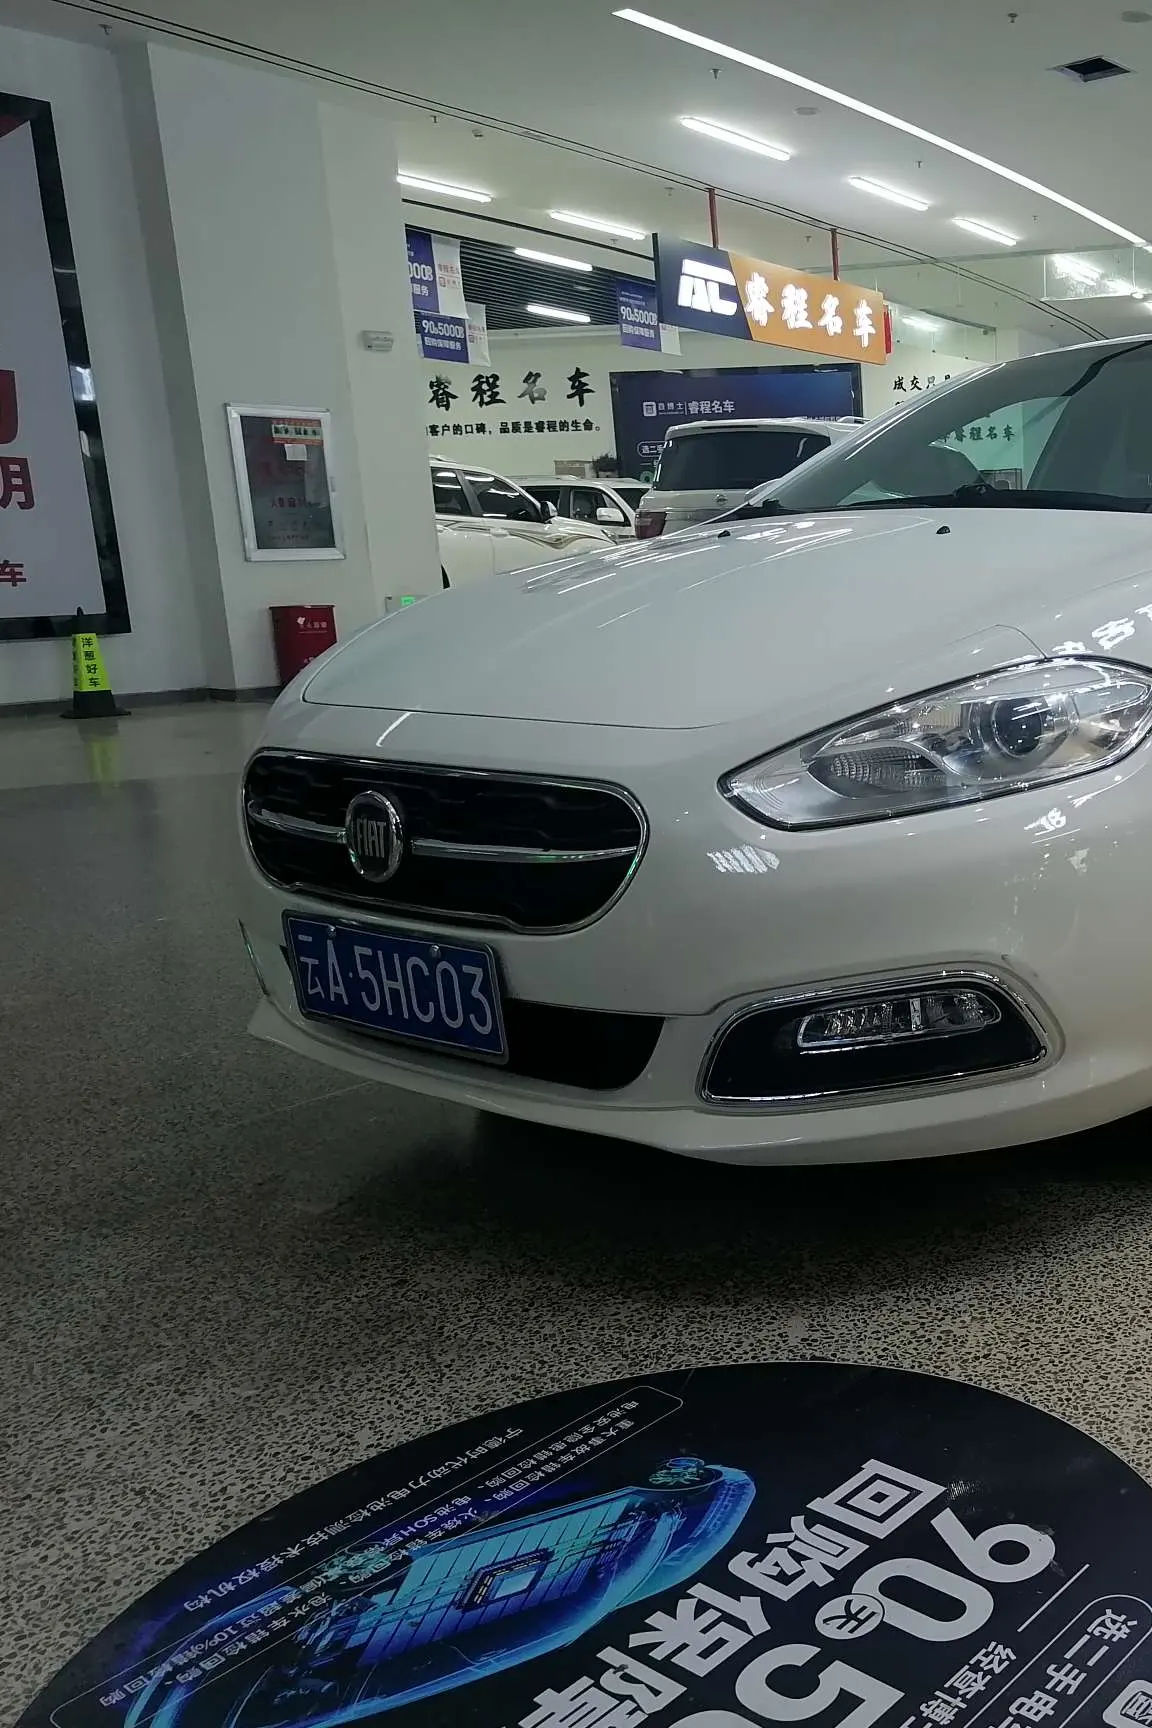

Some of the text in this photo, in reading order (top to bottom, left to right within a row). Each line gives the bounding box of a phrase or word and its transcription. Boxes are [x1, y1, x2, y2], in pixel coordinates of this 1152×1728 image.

[427, 366, 597, 412] 睿程名车
[688, 400, 736, 415] 睿程名车
[425, 418, 601, 437] 客户的口碑，品质是睿程的生命。
[354, 816, 387, 860] FIAT
[183, 1426, 524, 1613] 宁德时代动力电池检测技术授权机构
[988, 1608, 1138, 1728] 选二手电
